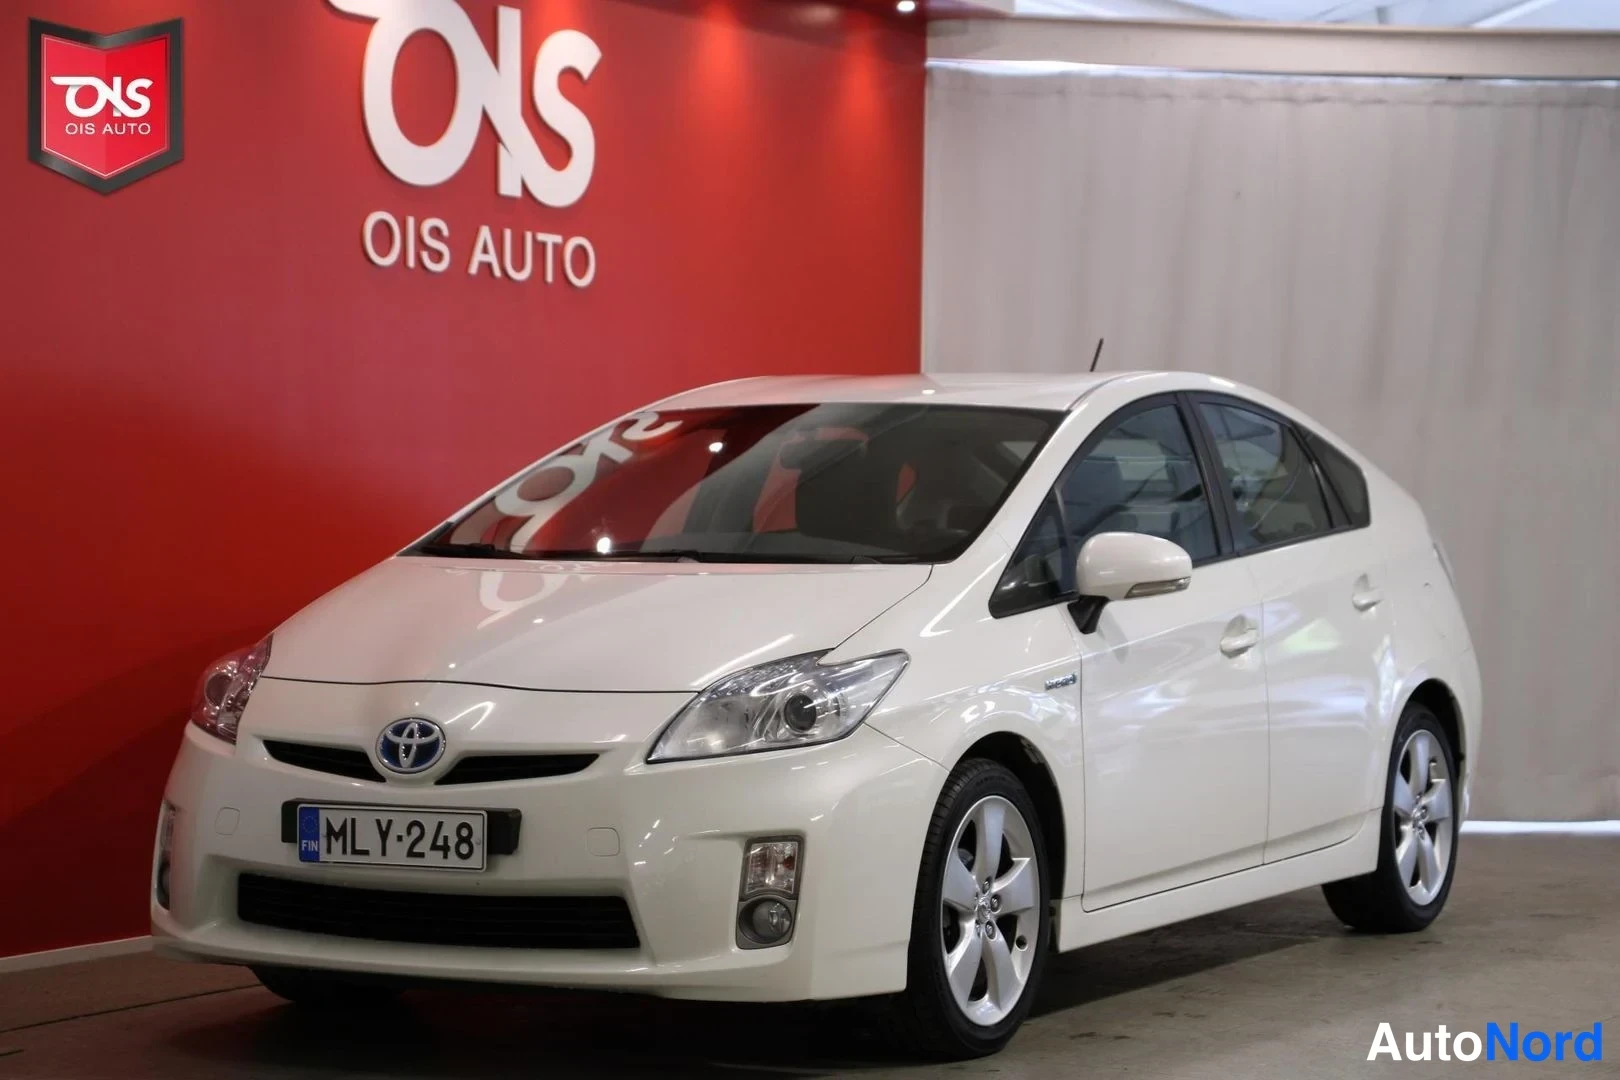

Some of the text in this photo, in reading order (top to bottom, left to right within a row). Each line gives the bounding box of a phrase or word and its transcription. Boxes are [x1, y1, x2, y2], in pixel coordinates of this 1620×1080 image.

[363, 210, 597, 288] OIS AUTO
[301, 816, 475, 861] FIN MLY-248
